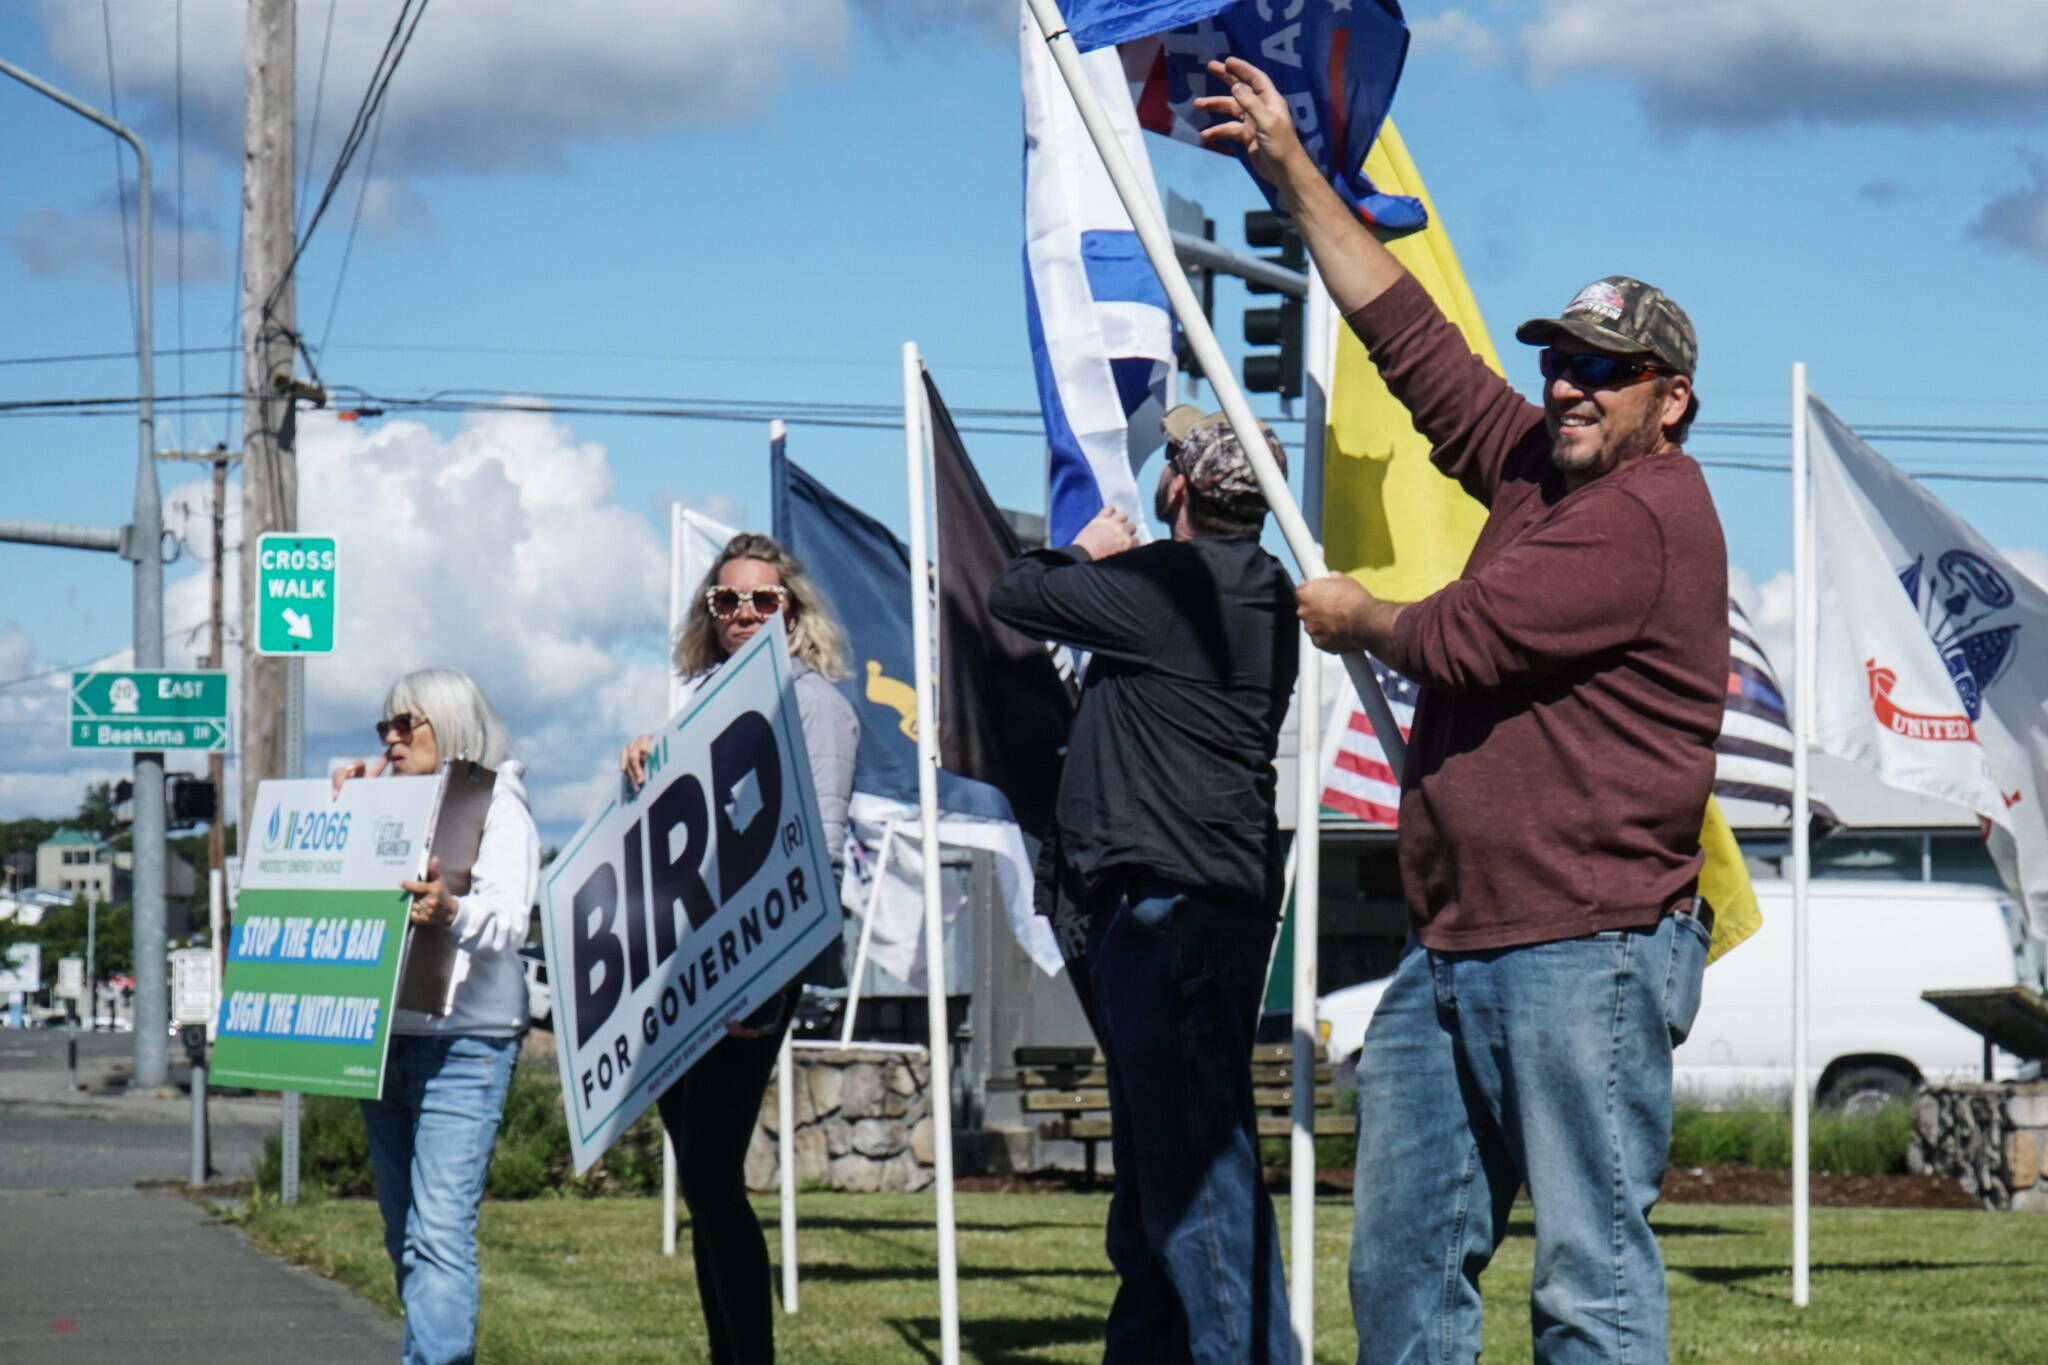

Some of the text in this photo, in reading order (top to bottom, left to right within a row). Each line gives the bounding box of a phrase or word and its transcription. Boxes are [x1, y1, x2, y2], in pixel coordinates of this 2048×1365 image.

[261, 550, 335, 571] CROSS
[268, 578, 326, 599] WALK
[113, 677, 204, 699] 20 EAST
[80, 724, 210, 746] S Beeksma DR
[1892, 711, 1970, 739] UNITED
[781, 814, 804, 858] (R)
[572, 709, 782, 1051] BIRD
[238, 916, 387, 961] STOP THE GAS BAN
[581, 1034, 632, 1110] FOR
[641, 866, 809, 1047] GOVERNOR
[225, 990, 380, 1040] SIGN THE INITIATIVE
